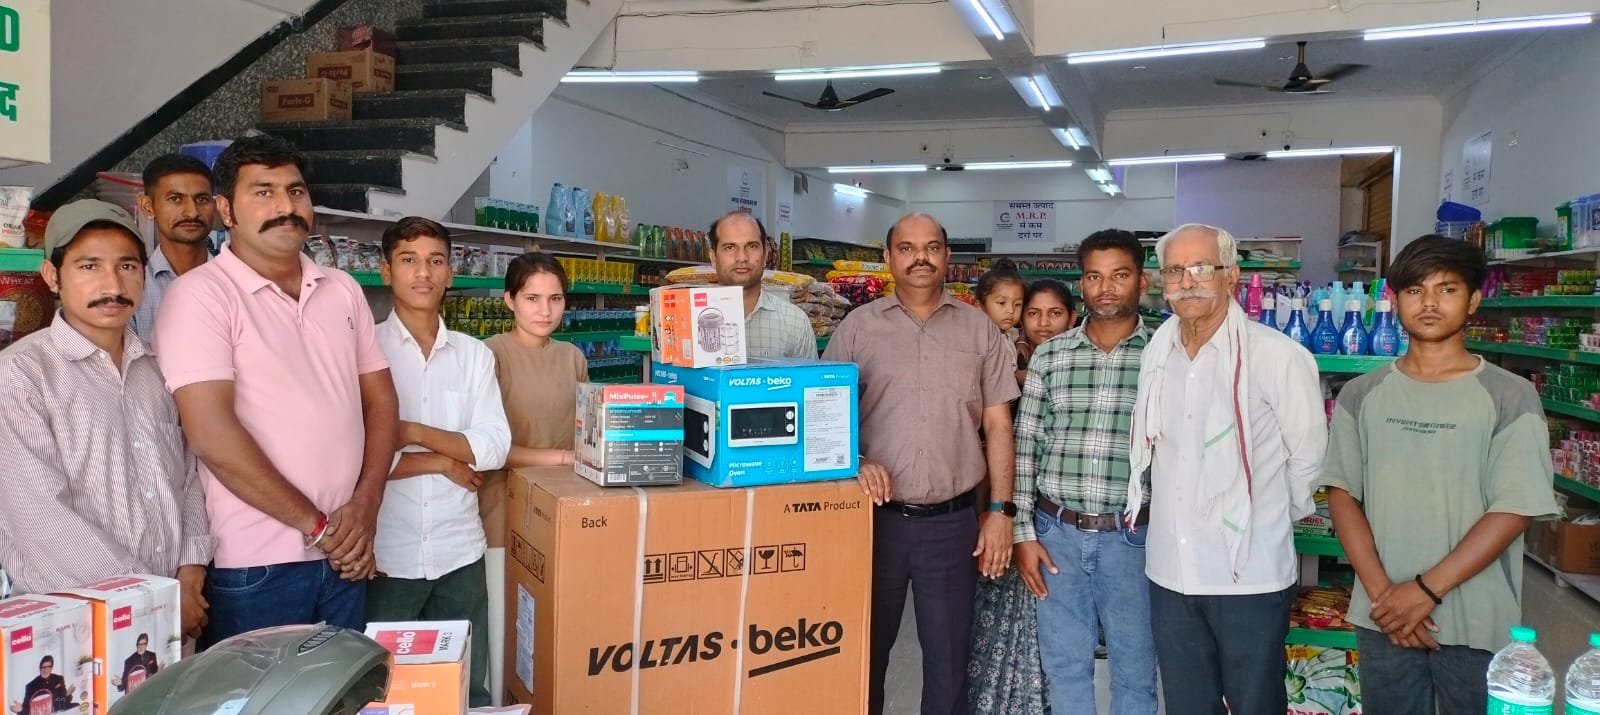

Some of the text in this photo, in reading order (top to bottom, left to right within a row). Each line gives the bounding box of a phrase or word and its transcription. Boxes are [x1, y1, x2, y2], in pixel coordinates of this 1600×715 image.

[1016, 212, 1047, 220] M.R.P.
[728, 377, 762, 388] VOLTAS
[767, 375, 792, 387] beko
[728, 469, 746, 477] Oven
[783, 499, 861, 513] A TATA Product
[581, 516, 608, 529] Back
[113, 614, 131, 623] cello
[11, 634, 32, 646] cello
[396, 631, 417, 655] cello
[439, 634, 452, 651] MARK
[587, 617, 844, 677] VOLTAS beko
